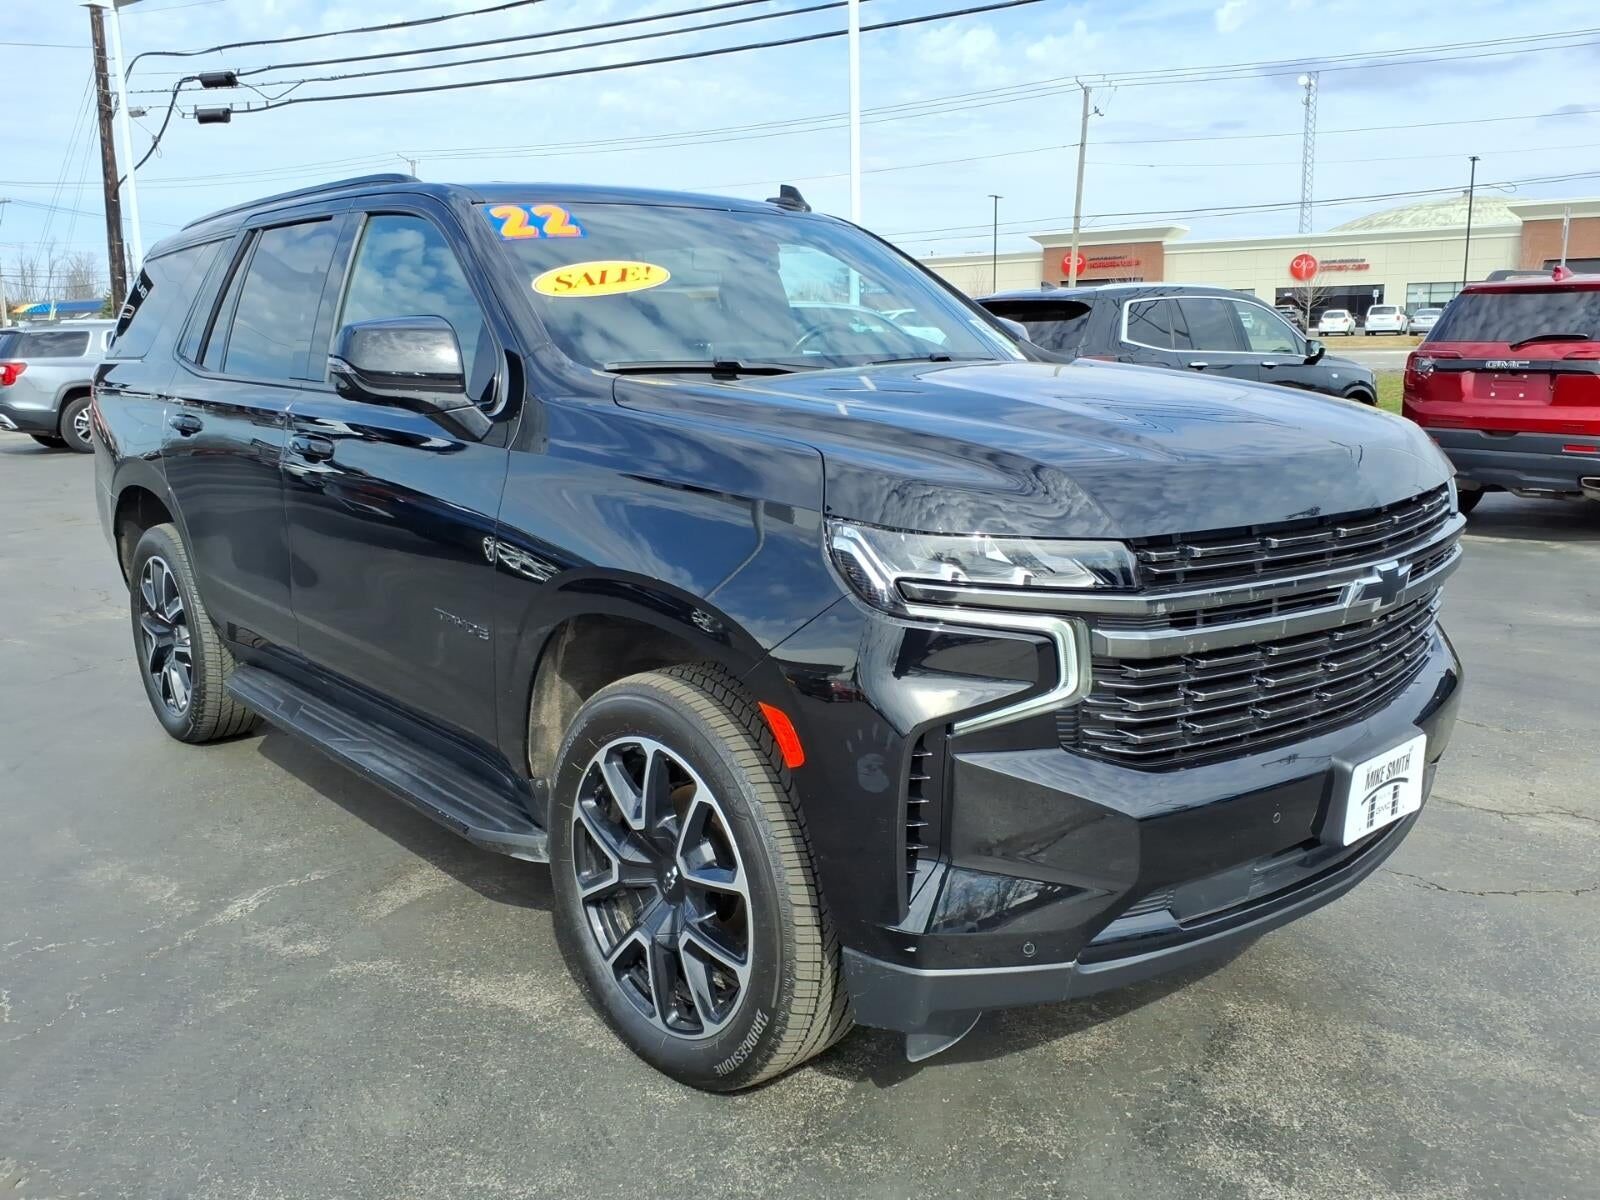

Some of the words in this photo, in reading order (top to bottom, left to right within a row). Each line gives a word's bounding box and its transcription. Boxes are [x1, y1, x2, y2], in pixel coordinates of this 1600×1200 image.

[489, 204, 582, 238] 22
[553, 265, 651, 292] SALE!
[1364, 764, 1386, 791] MIKE
[1386, 753, 1411, 780] SMITH
[713, 1008, 769, 1077] BRIDGESTONE
